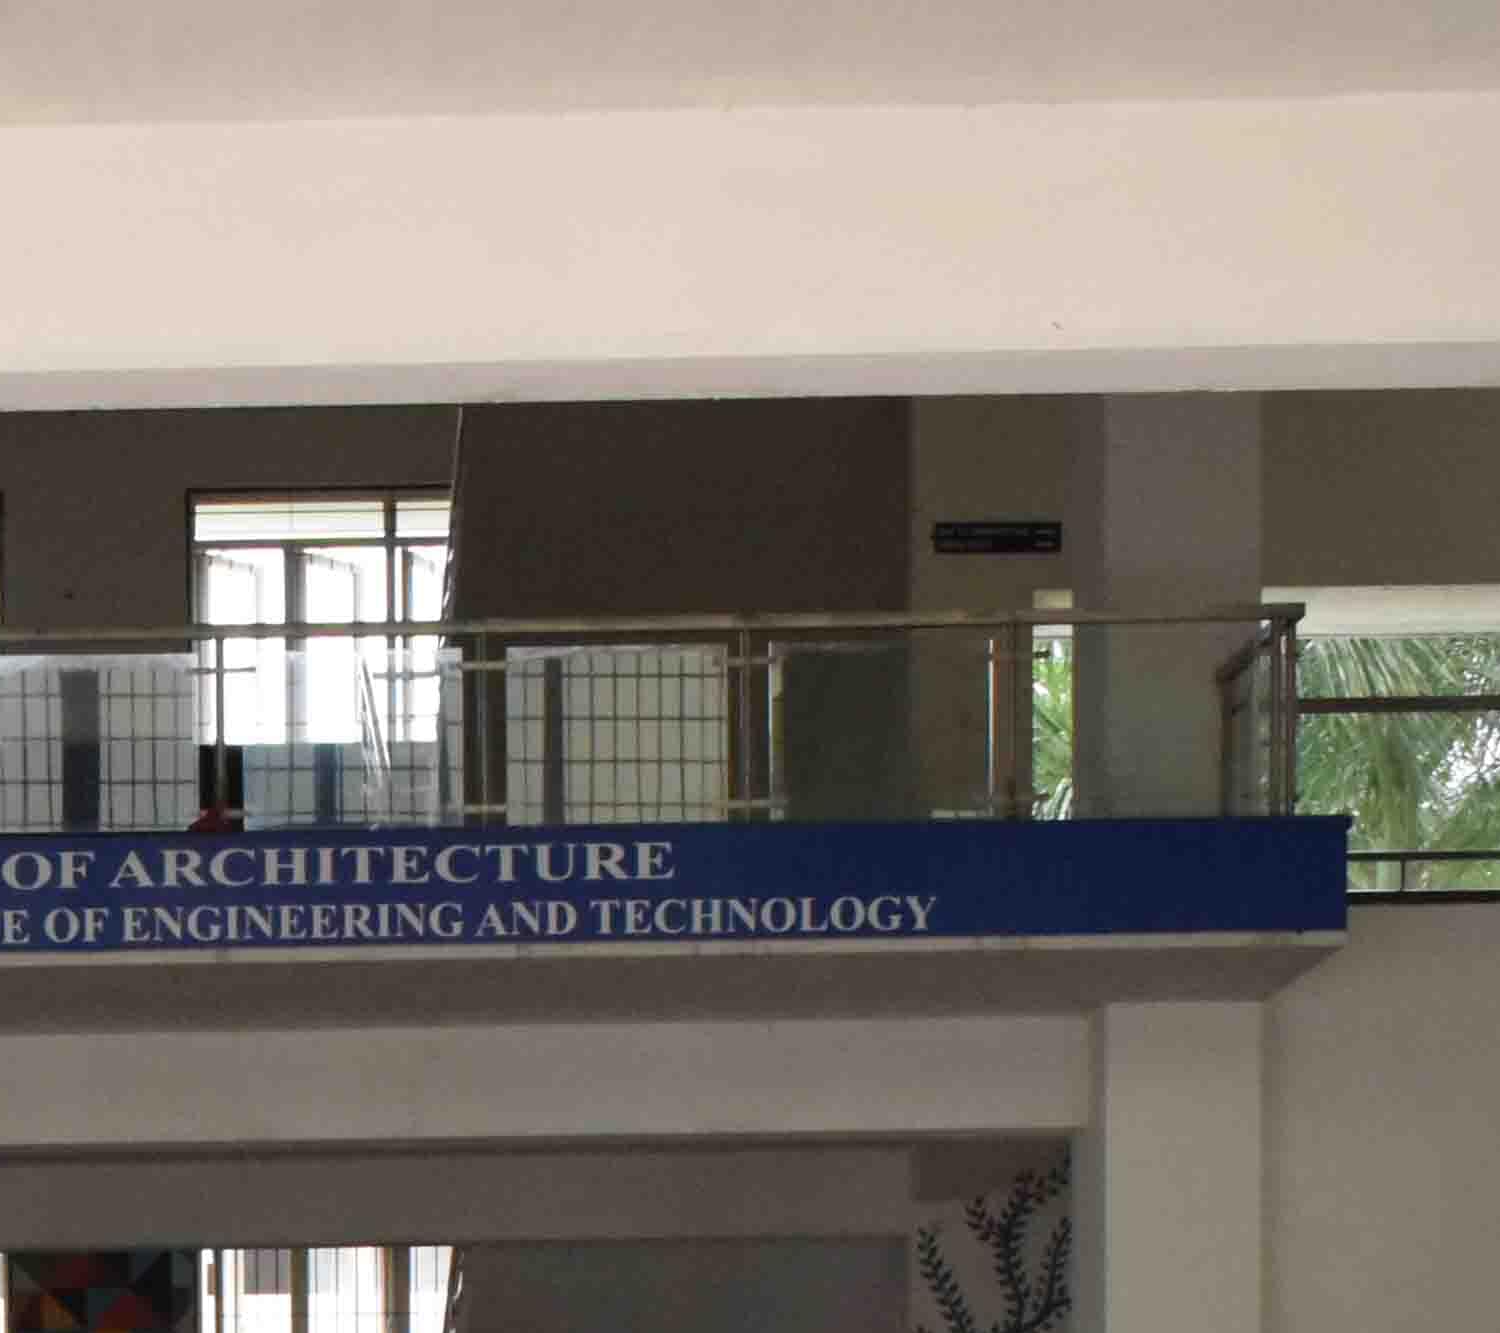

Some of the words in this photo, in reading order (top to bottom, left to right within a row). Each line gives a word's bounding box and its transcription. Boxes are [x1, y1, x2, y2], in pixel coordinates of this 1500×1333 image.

[0, 850, 96, 891] OF
[108, 841, 676, 888] ARCHITECTURE
[44, 906, 109, 944] OF
[121, 901, 465, 943] ENGINEERING
[475, 900, 578, 938] AND
[589, 896, 937, 935] TECHNOLOGY
